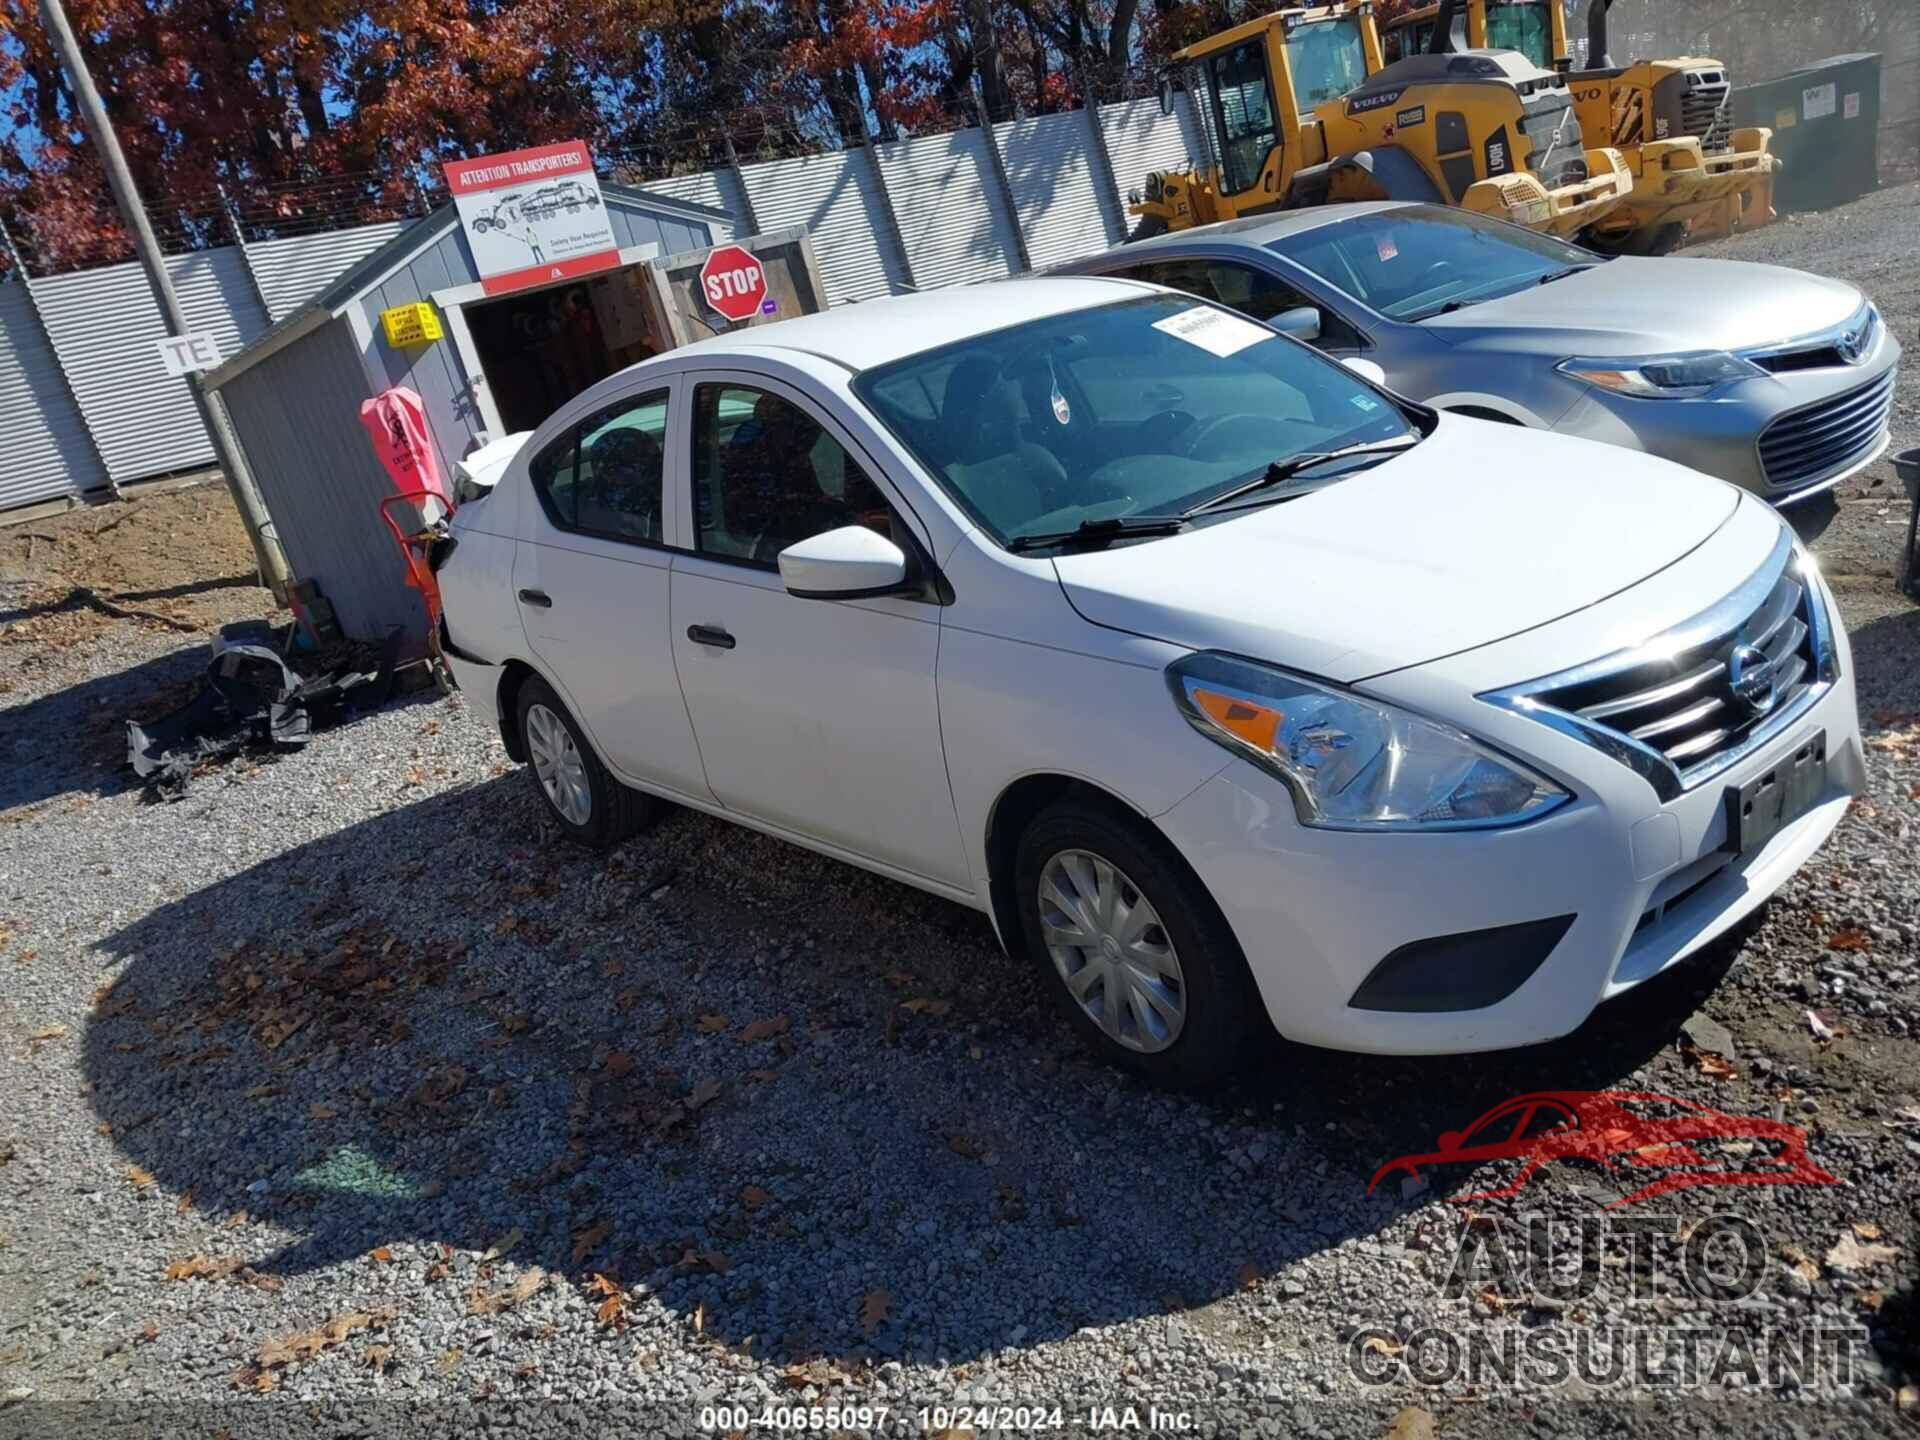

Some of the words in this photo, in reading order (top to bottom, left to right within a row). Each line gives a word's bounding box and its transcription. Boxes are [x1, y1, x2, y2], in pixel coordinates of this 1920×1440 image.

[1353, 92, 1399, 109] VOLVO
[459, 164, 510, 187] ATTENTION
[510, 151, 583, 177] TRANSPORTERS!
[1489, 142, 1504, 171] L90H
[706, 266, 760, 301] STOP
[165, 337, 213, 367] TE
